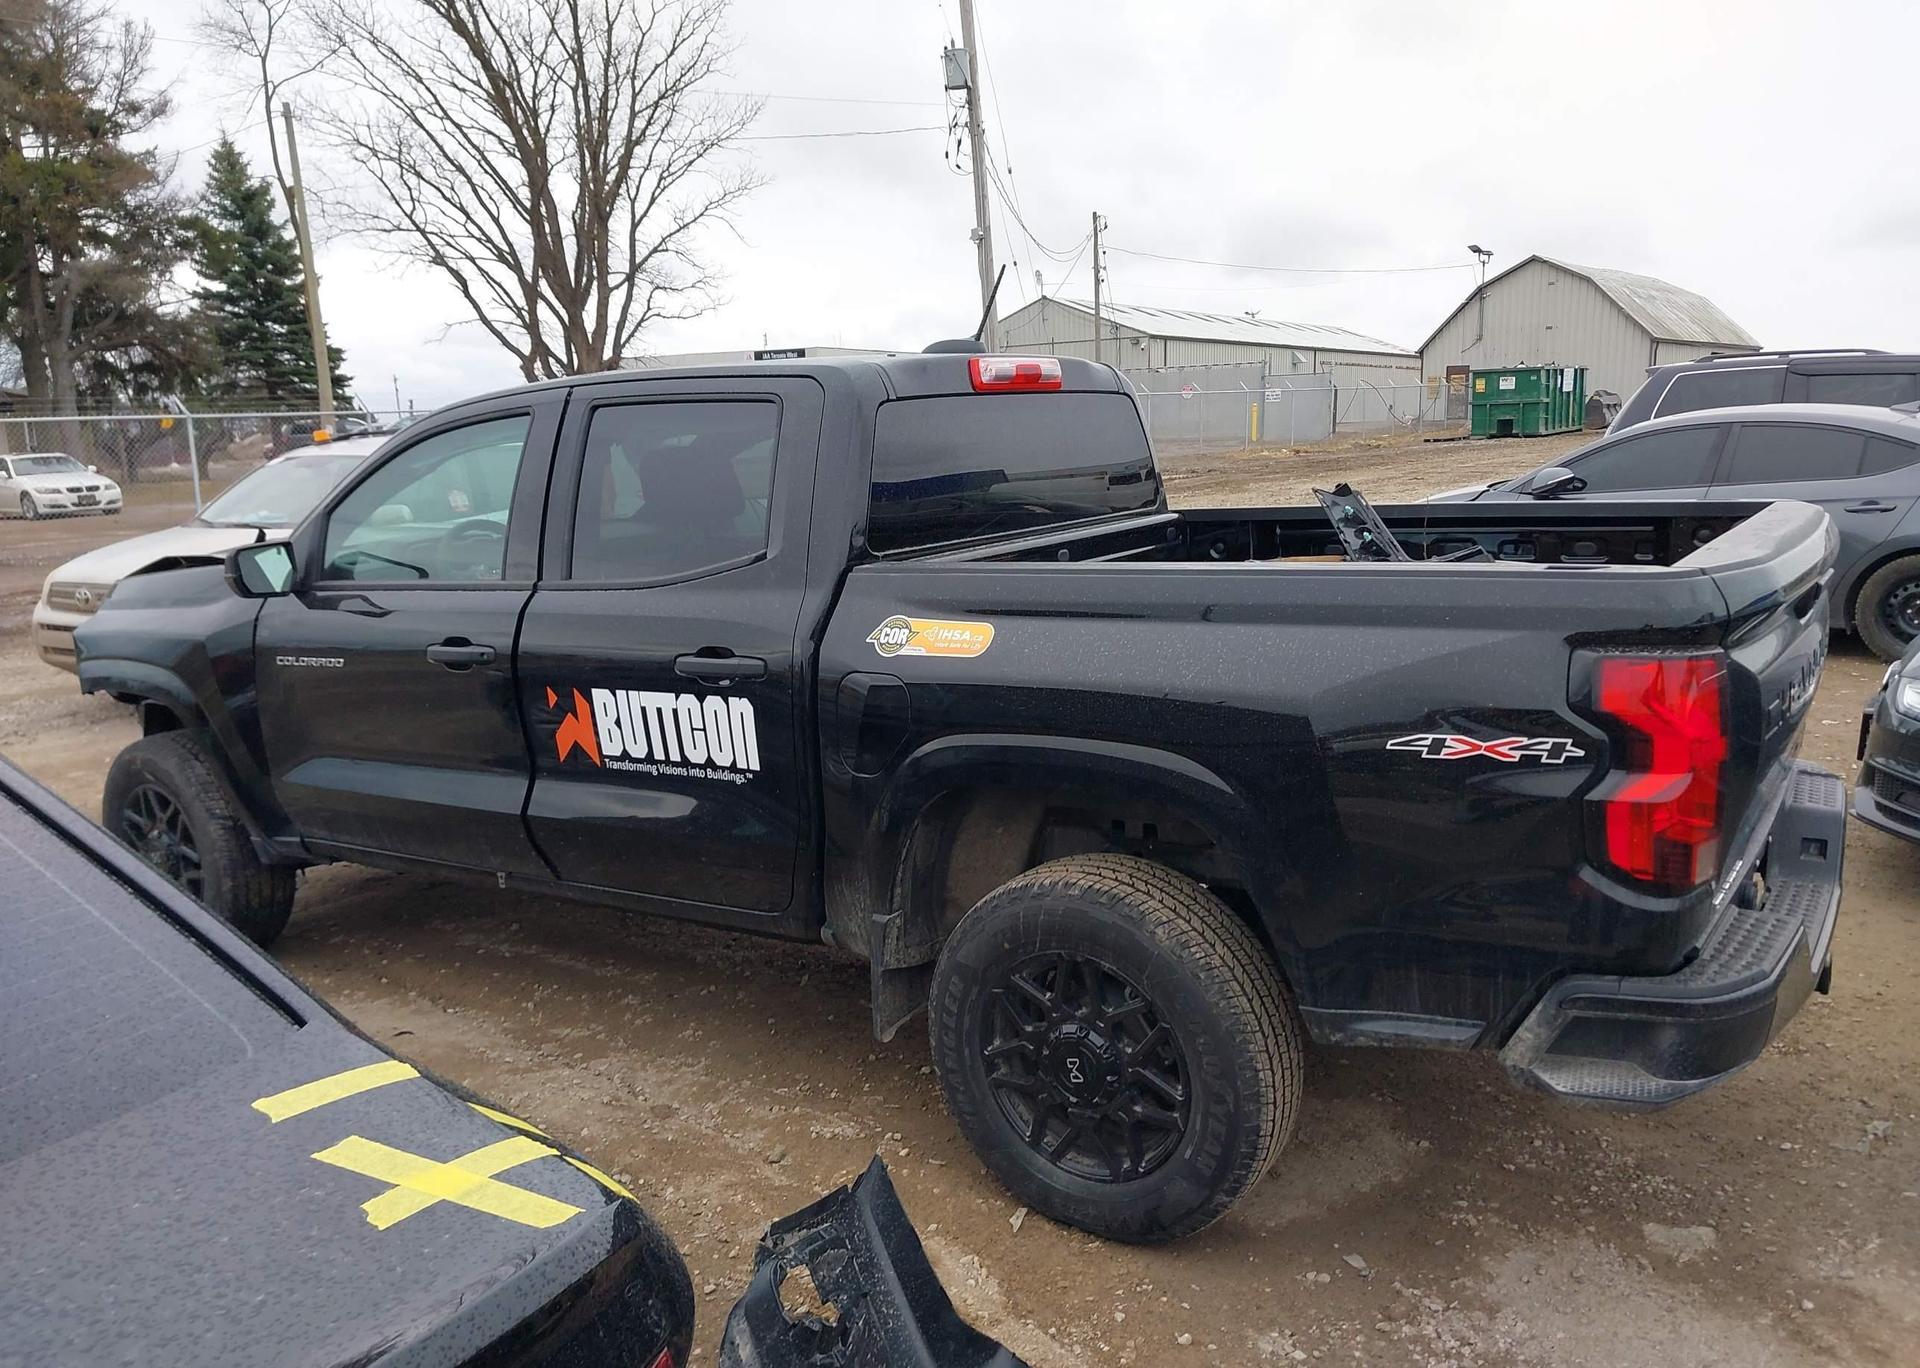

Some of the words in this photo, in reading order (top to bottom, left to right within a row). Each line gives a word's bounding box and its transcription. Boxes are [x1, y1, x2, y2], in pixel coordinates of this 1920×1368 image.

[880, 627, 910, 645] COR
[276, 656, 344, 668] COLORADO
[590, 688, 760, 771] BUTTCON
[604, 758, 658, 775] Transforming
[658, 764, 688, 776] Visions
[688, 766, 706, 778] into
